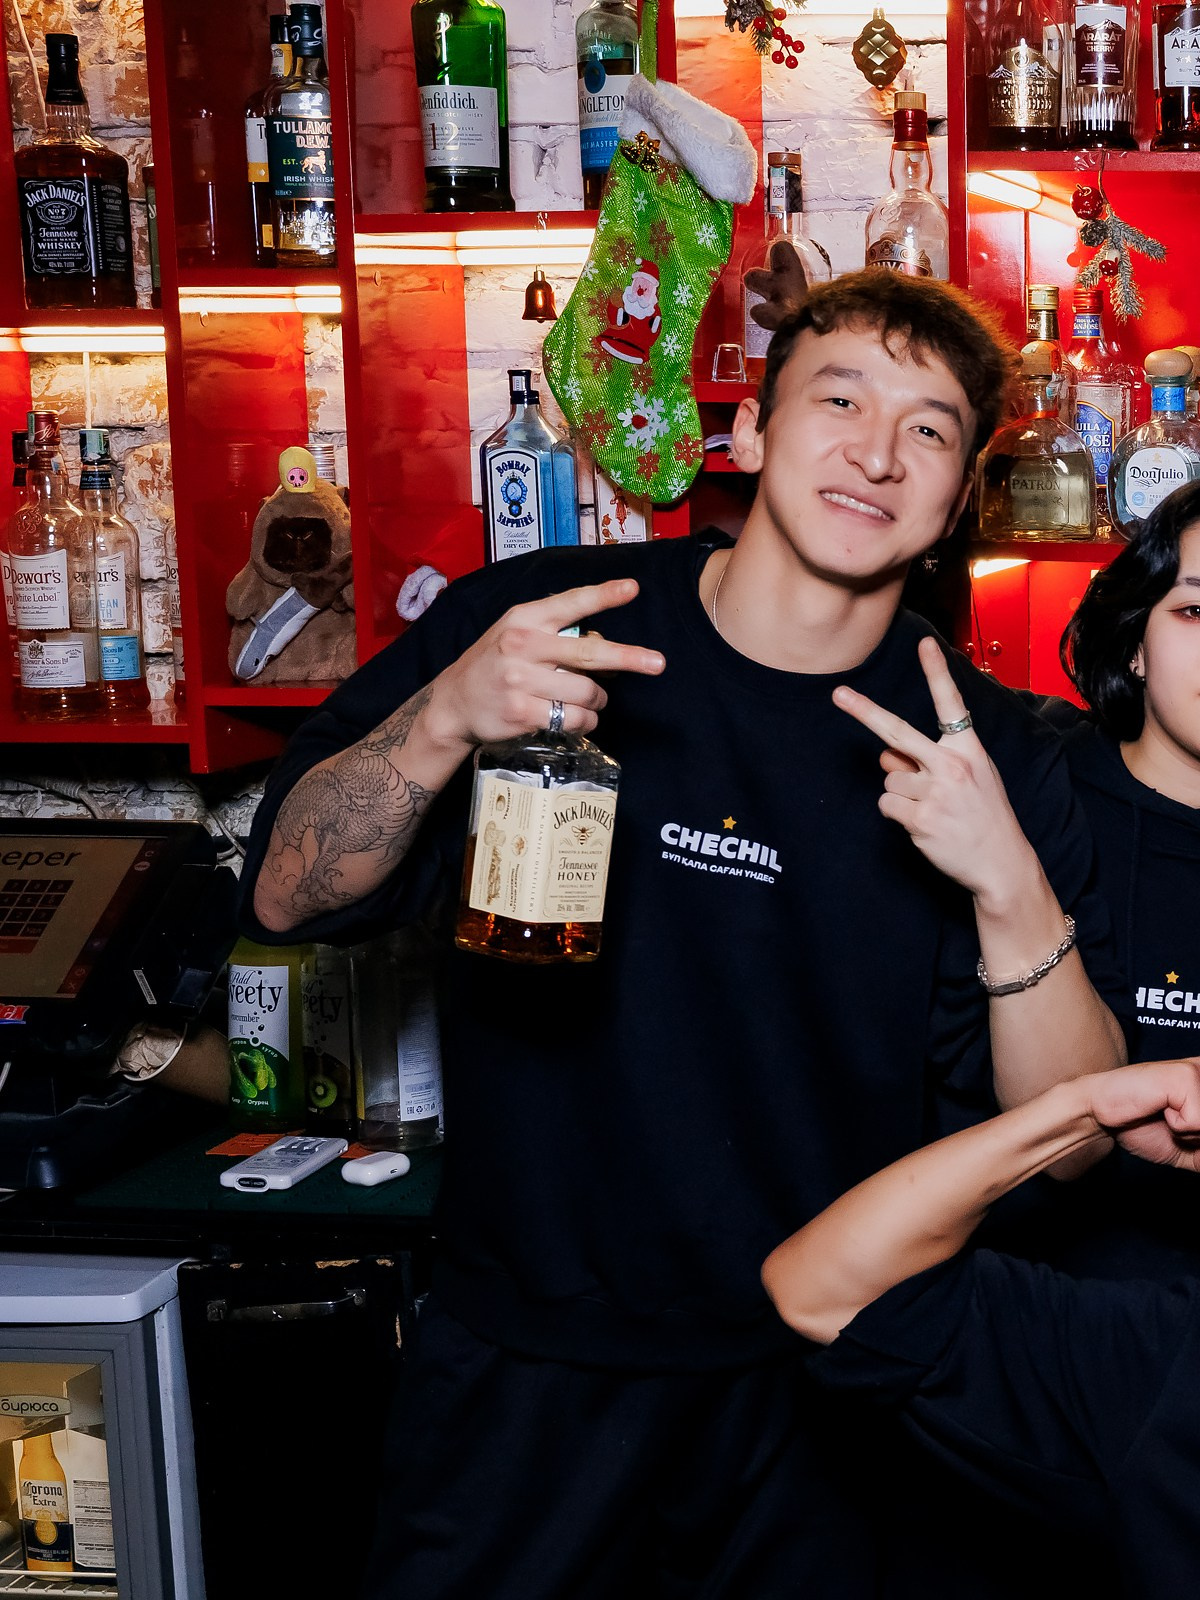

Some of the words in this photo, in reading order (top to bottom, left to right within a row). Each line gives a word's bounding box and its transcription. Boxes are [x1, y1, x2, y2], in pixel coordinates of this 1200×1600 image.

[1080, 30, 1122, 42] ARARAT
[25, 186, 50, 208] JACK
[48, 184, 86, 207] DANIEL'S
[39, 227, 78, 238] Tennessee
[37, 242, 82, 250] WHISKEY
[495, 460, 532, 478] BOMBAY
[496, 512, 534, 528] SAPPHIRE
[504, 530, 530, 538] Distilled
[12, 569, 61, 584] Dewar's
[32, 592, 57, 602] Label
[554, 806, 578, 830] JACK
[580, 801, 615, 832] DANIEL'S
[660, 822, 783, 873] CHECHIL
[559, 856, 598, 870] Tennessee
[557, 872, 598, 881] HONEY
[1, 1398, 59, 1414] бирюса
[23, 1481, 63, 1498] Corona
[32, 1496, 57, 1506] Extra
